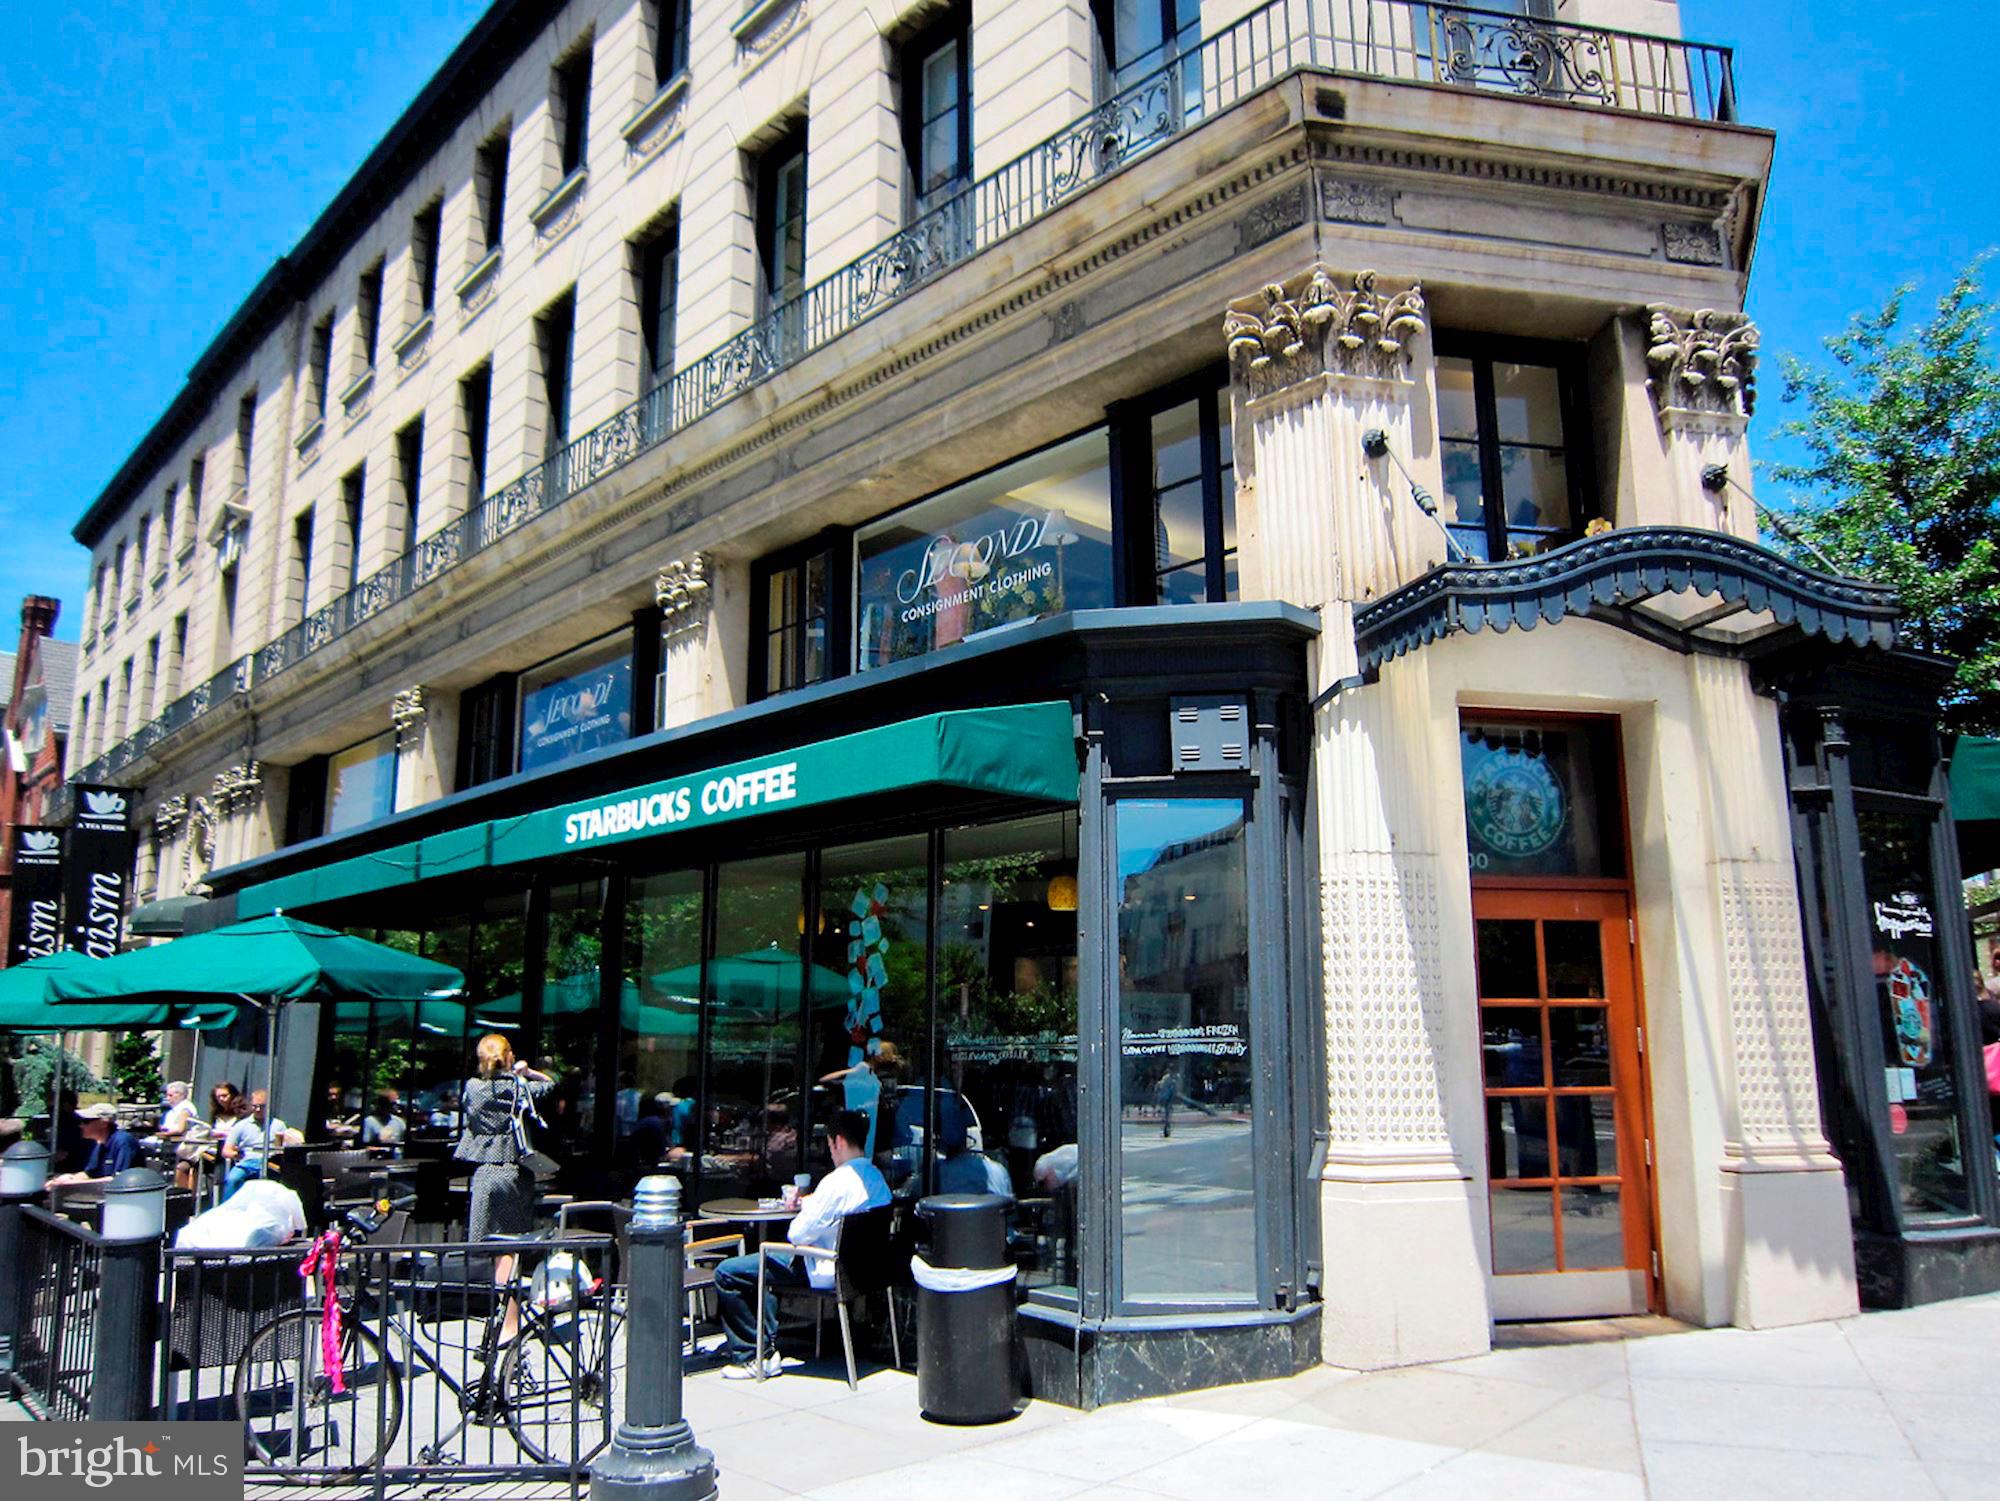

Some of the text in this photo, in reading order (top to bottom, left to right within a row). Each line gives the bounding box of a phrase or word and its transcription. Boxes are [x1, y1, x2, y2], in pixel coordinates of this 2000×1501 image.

[897, 510, 1050, 604] SECONDI
[901, 562, 1052, 623] CONSIGNMENT CLOTHING
[565, 762, 797, 843] STARBUCKS COFFEE
[1484, 823, 1551, 851] COFFEE
[19, 900, 57, 958] ism
